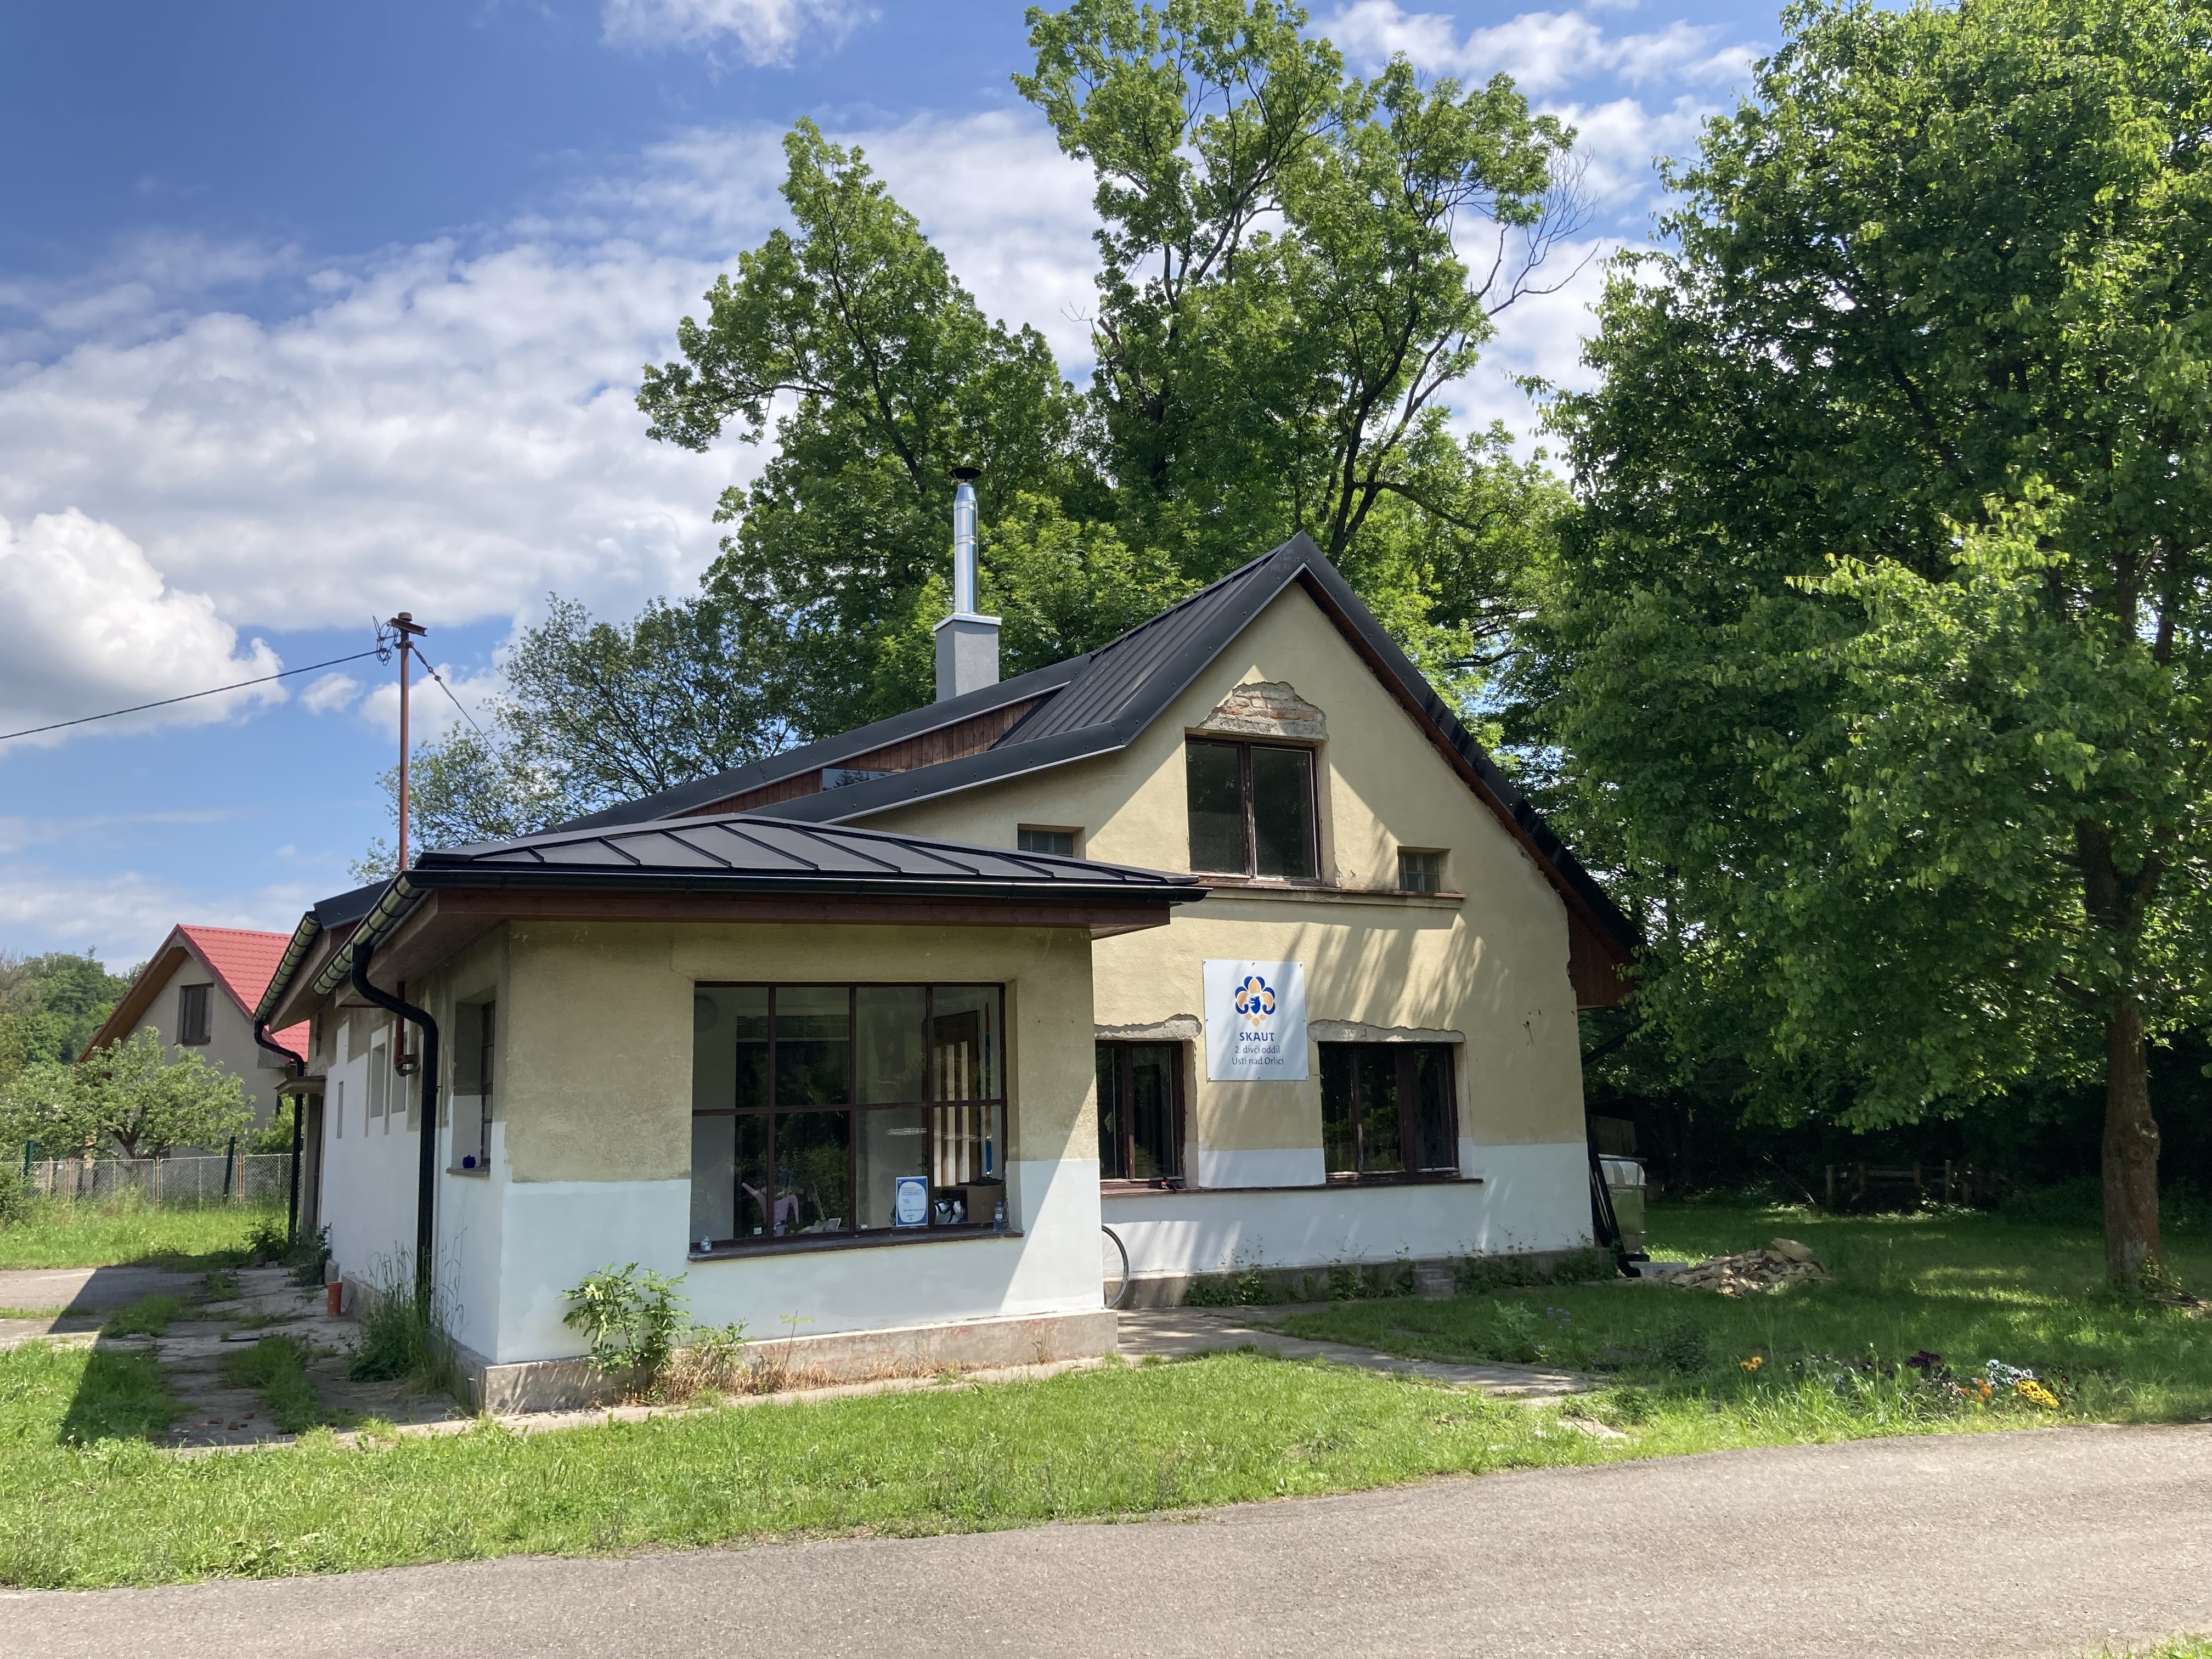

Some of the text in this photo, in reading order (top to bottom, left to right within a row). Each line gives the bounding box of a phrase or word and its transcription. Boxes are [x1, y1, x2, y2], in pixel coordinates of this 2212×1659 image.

[1239, 1032, 1274, 1041] SKAUT
[1243, 1045, 1260, 1053] dívčí
[1262, 1045, 1280, 1053] oddíl
[1232, 1055, 1246, 1065] Ústí
[1264, 1057, 1284, 1065] Orlicí
